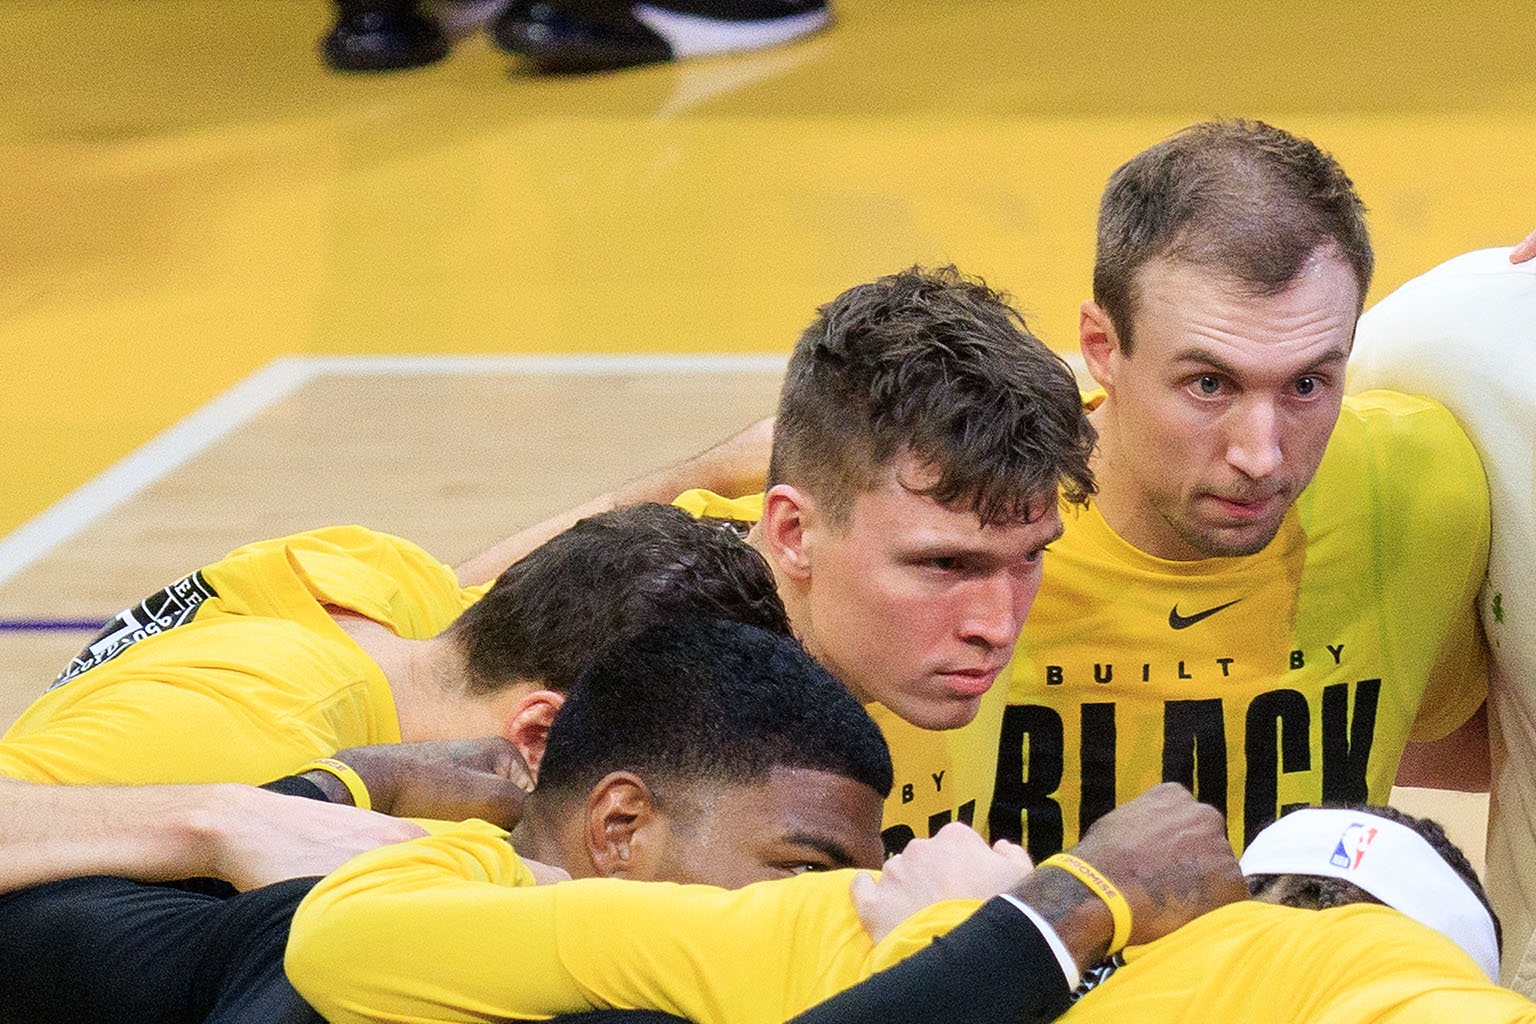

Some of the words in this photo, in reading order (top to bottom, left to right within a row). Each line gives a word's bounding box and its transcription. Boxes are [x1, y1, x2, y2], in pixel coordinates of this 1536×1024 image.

[1045, 657, 1234, 686] BUILT
[1289, 643, 1345, 671] BY
[901, 770, 945, 805] BY
[988, 678, 1383, 863] BLACK
